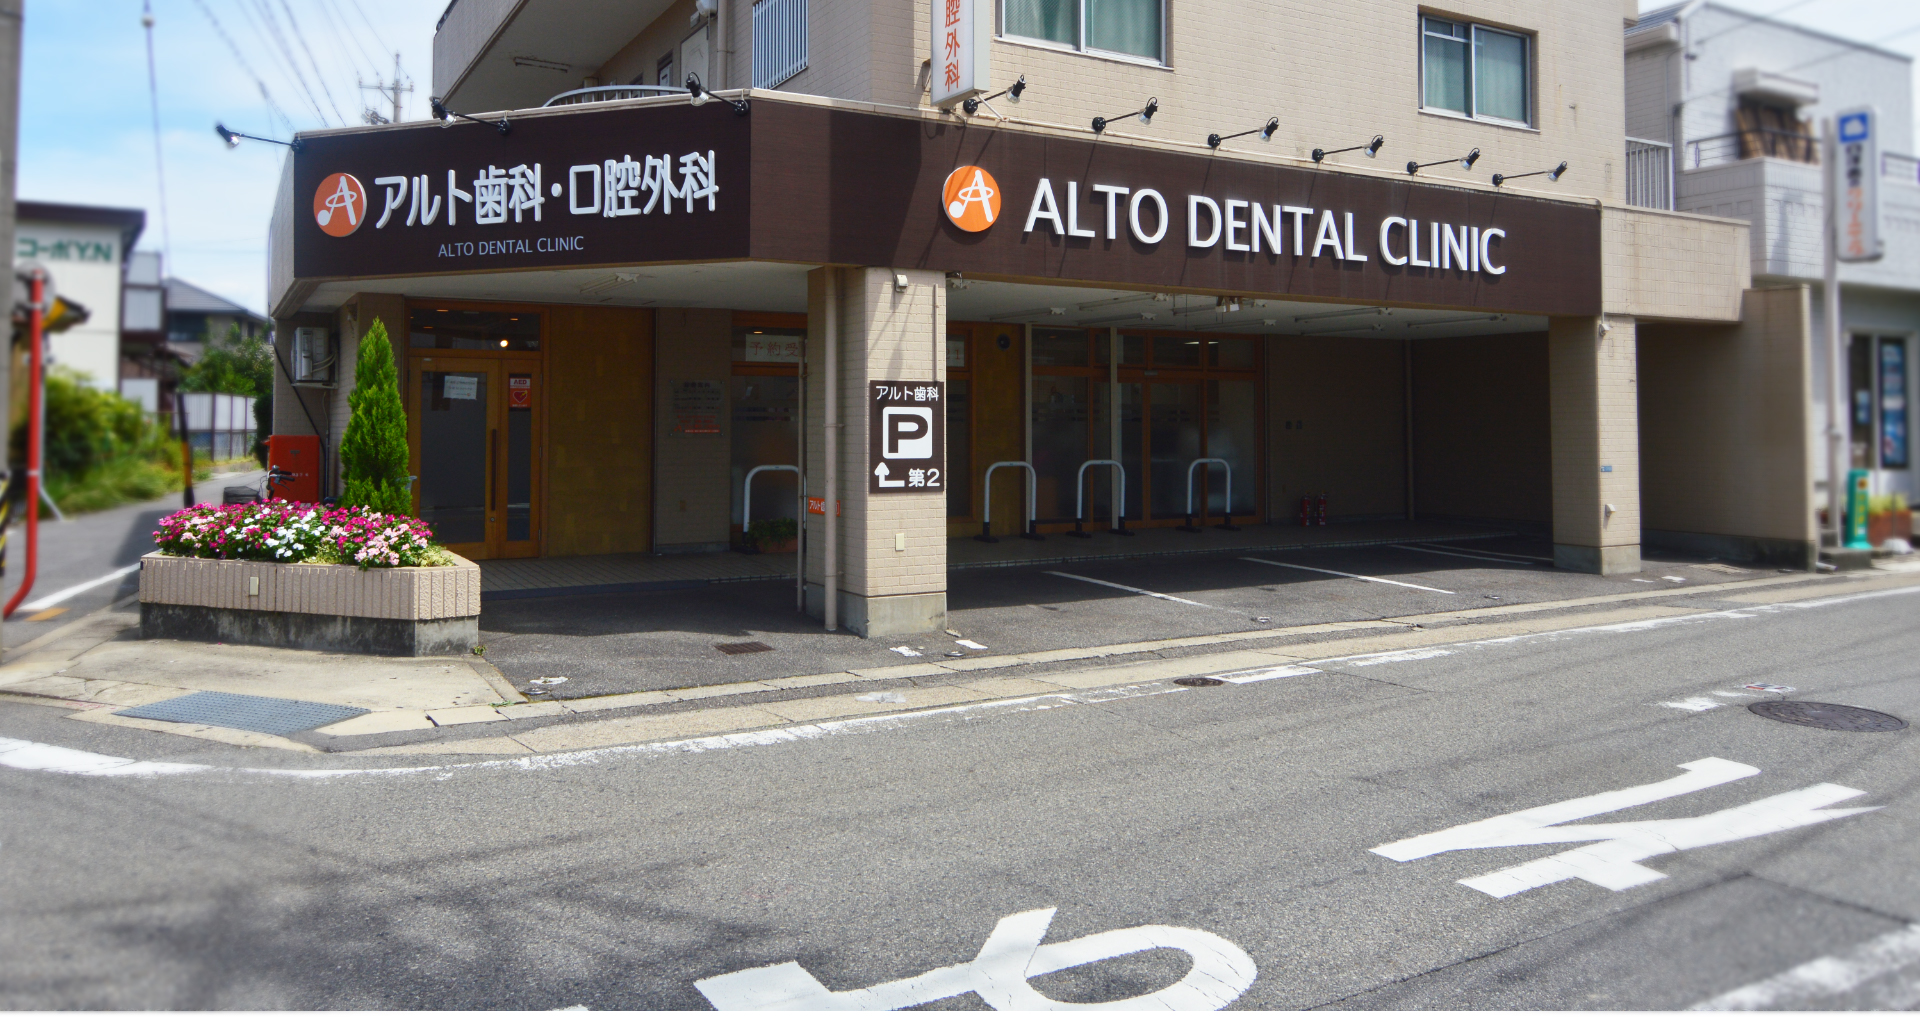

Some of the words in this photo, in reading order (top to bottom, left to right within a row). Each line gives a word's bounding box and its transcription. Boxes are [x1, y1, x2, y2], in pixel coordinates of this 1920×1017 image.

[1024, 178, 1169, 244] ALTO
[1187, 194, 1368, 263] DENTAL
[1379, 216, 1507, 275] CLINIC
[438, 242, 475, 258] ALTO
[478, 240, 533, 256] DENTAL
[536, 235, 585, 253] CLINIC
[875, 385, 939, 402] アルト歯科
[888, 414, 928, 453] P
[908, 467, 941, 488] 第2
